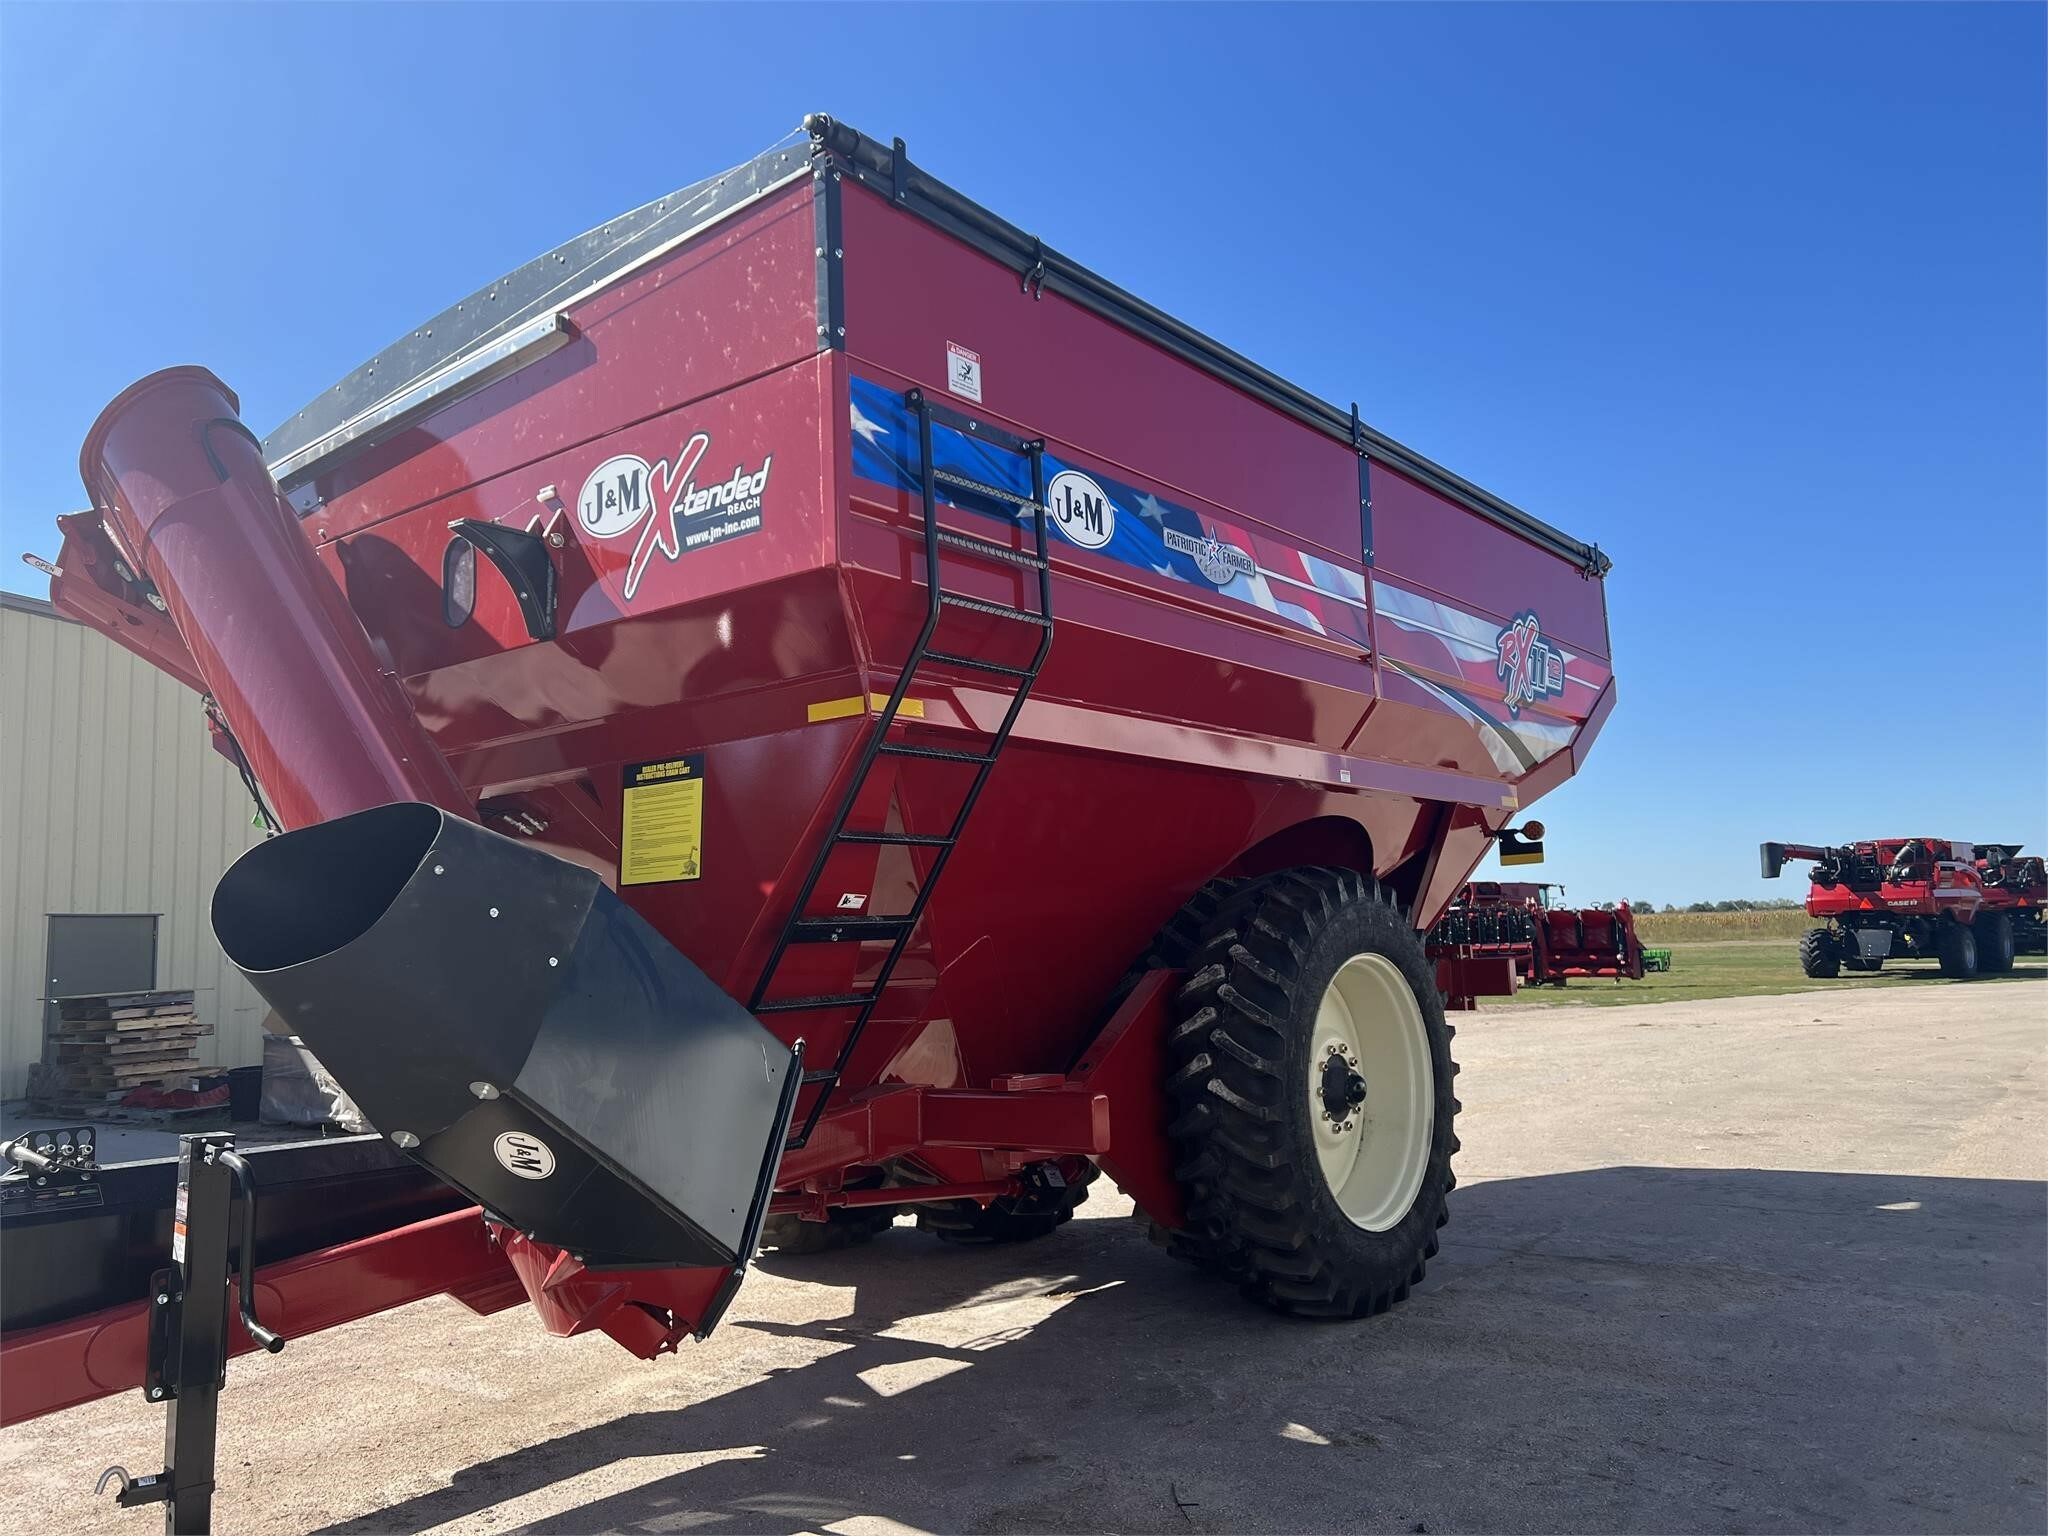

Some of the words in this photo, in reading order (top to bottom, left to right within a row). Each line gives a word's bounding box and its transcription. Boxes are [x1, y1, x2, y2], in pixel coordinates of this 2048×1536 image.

[586, 468, 642, 525] J&M
[727, 496, 761, 517] REACH
[1055, 484, 1105, 537] J&M
[685, 515, 761, 547] www.jm-inc.com
[34, 560, 56, 573] OPEN
[1166, 531, 1207, 557] PATRIOTIC
[1222, 551, 1253, 573] FARMER
[506, 1136, 543, 1174] J&M
